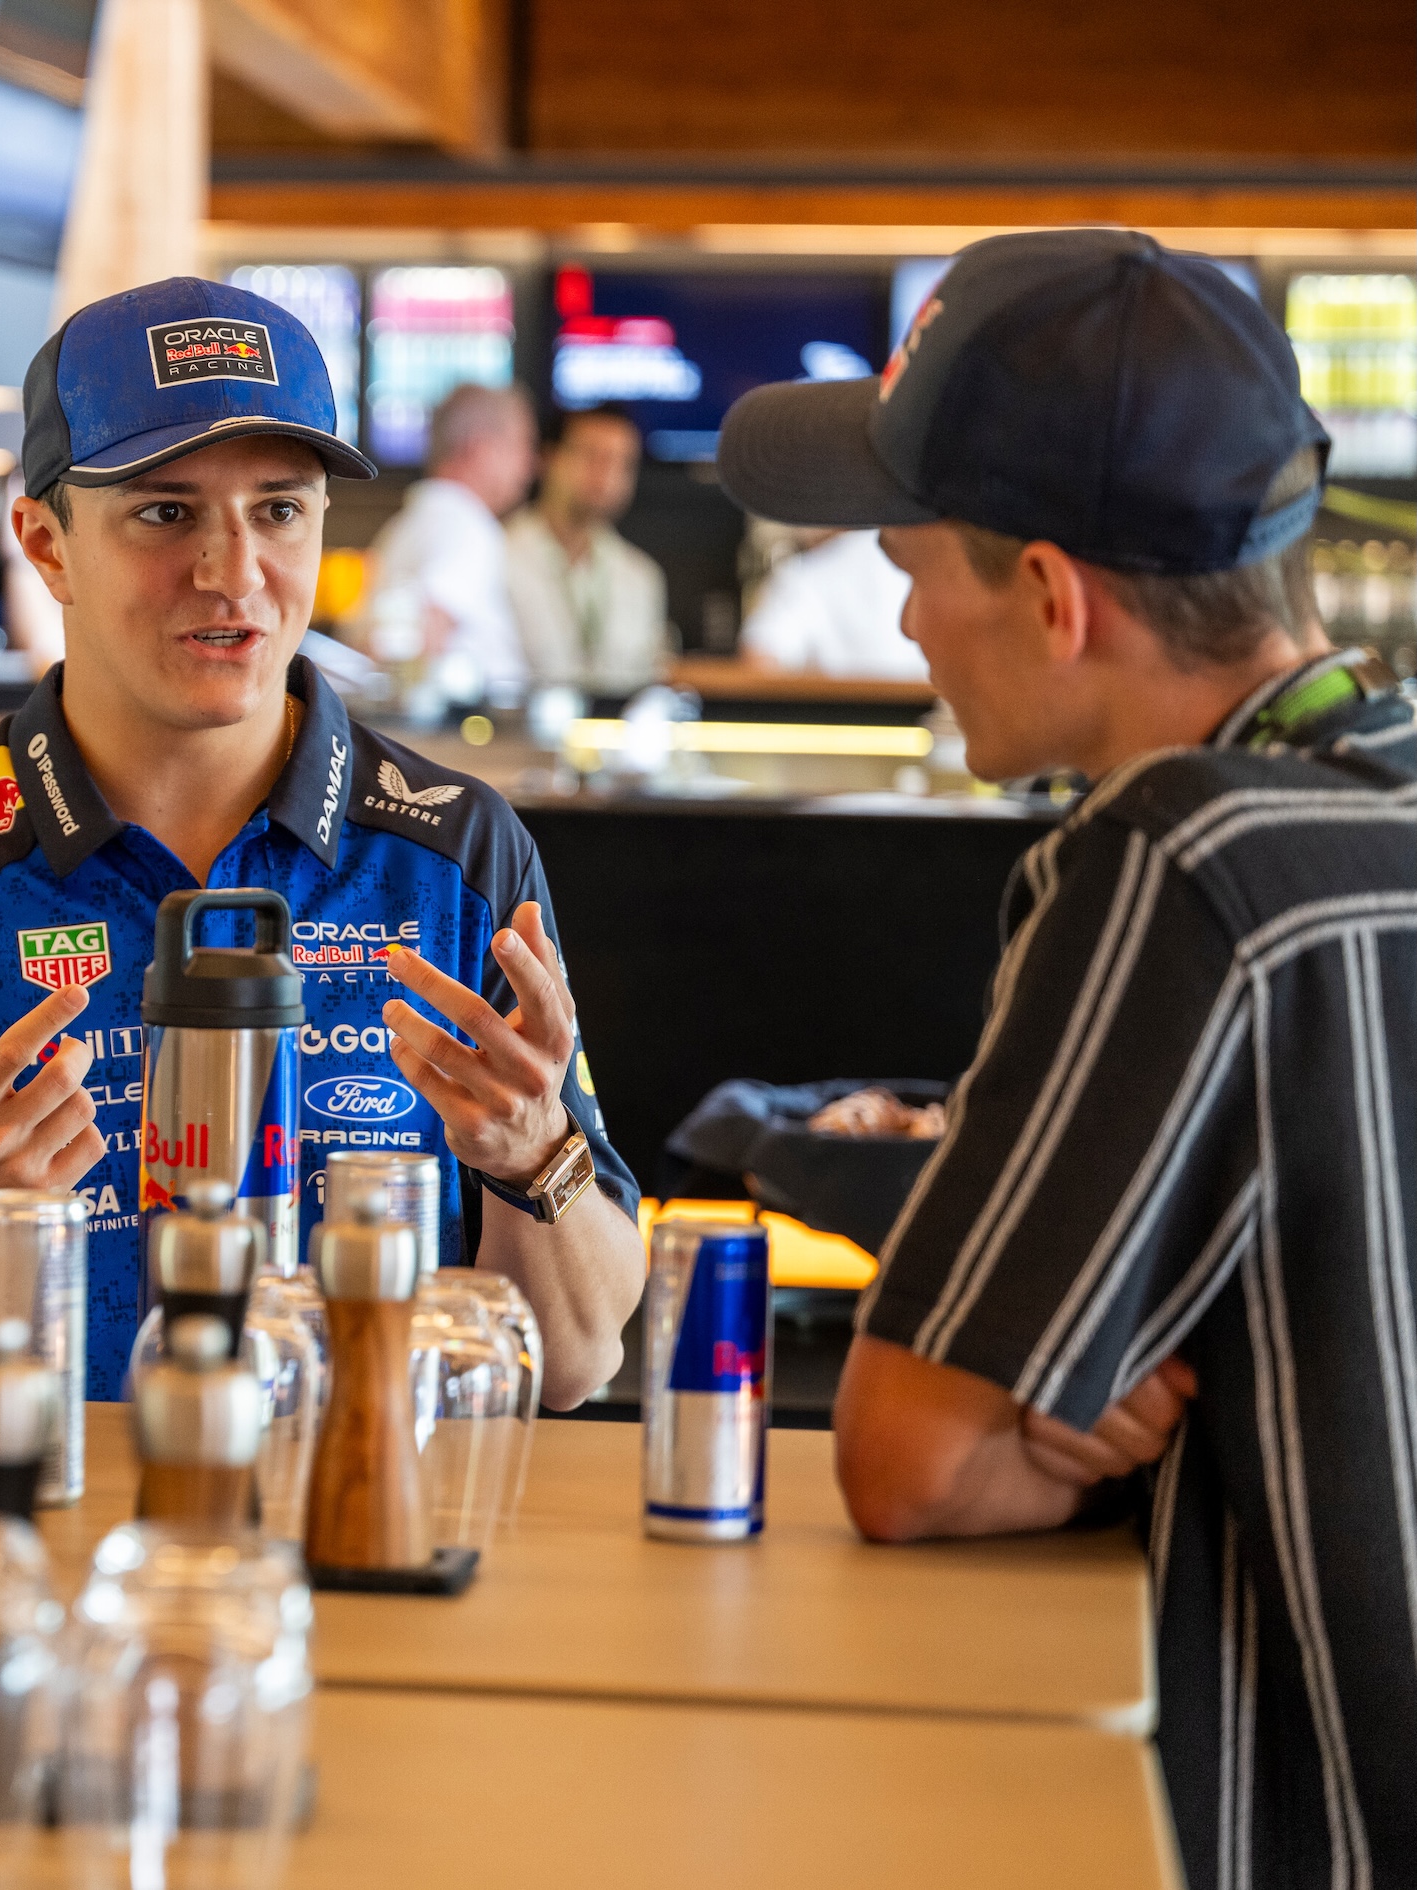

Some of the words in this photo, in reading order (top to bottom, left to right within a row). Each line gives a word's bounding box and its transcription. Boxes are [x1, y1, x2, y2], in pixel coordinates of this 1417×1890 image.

[164, 327, 259, 346] ORACLE
[166, 345, 194, 362] Red
[194, 342, 222, 358] Bull
[169, 360, 265, 376] RACING
[36, 752, 80, 836] 1Password
[316, 734, 347, 846] DAMAC
[364, 795, 443, 827] CASTORE
[26, 929, 100, 955] TAG
[292, 921, 421, 942] ORACLE
[292, 944, 328, 964] Red
[327, 944, 364, 964] Bull
[28, 957, 105, 986] HEUER
[119, 1029, 133, 1054] 1
[327, 1081, 398, 1114] Ford
[146, 1121, 209, 1168] Bull
[299, 1129, 420, 1146] RACING
[84, 1214, 139, 1233] NFINITE
